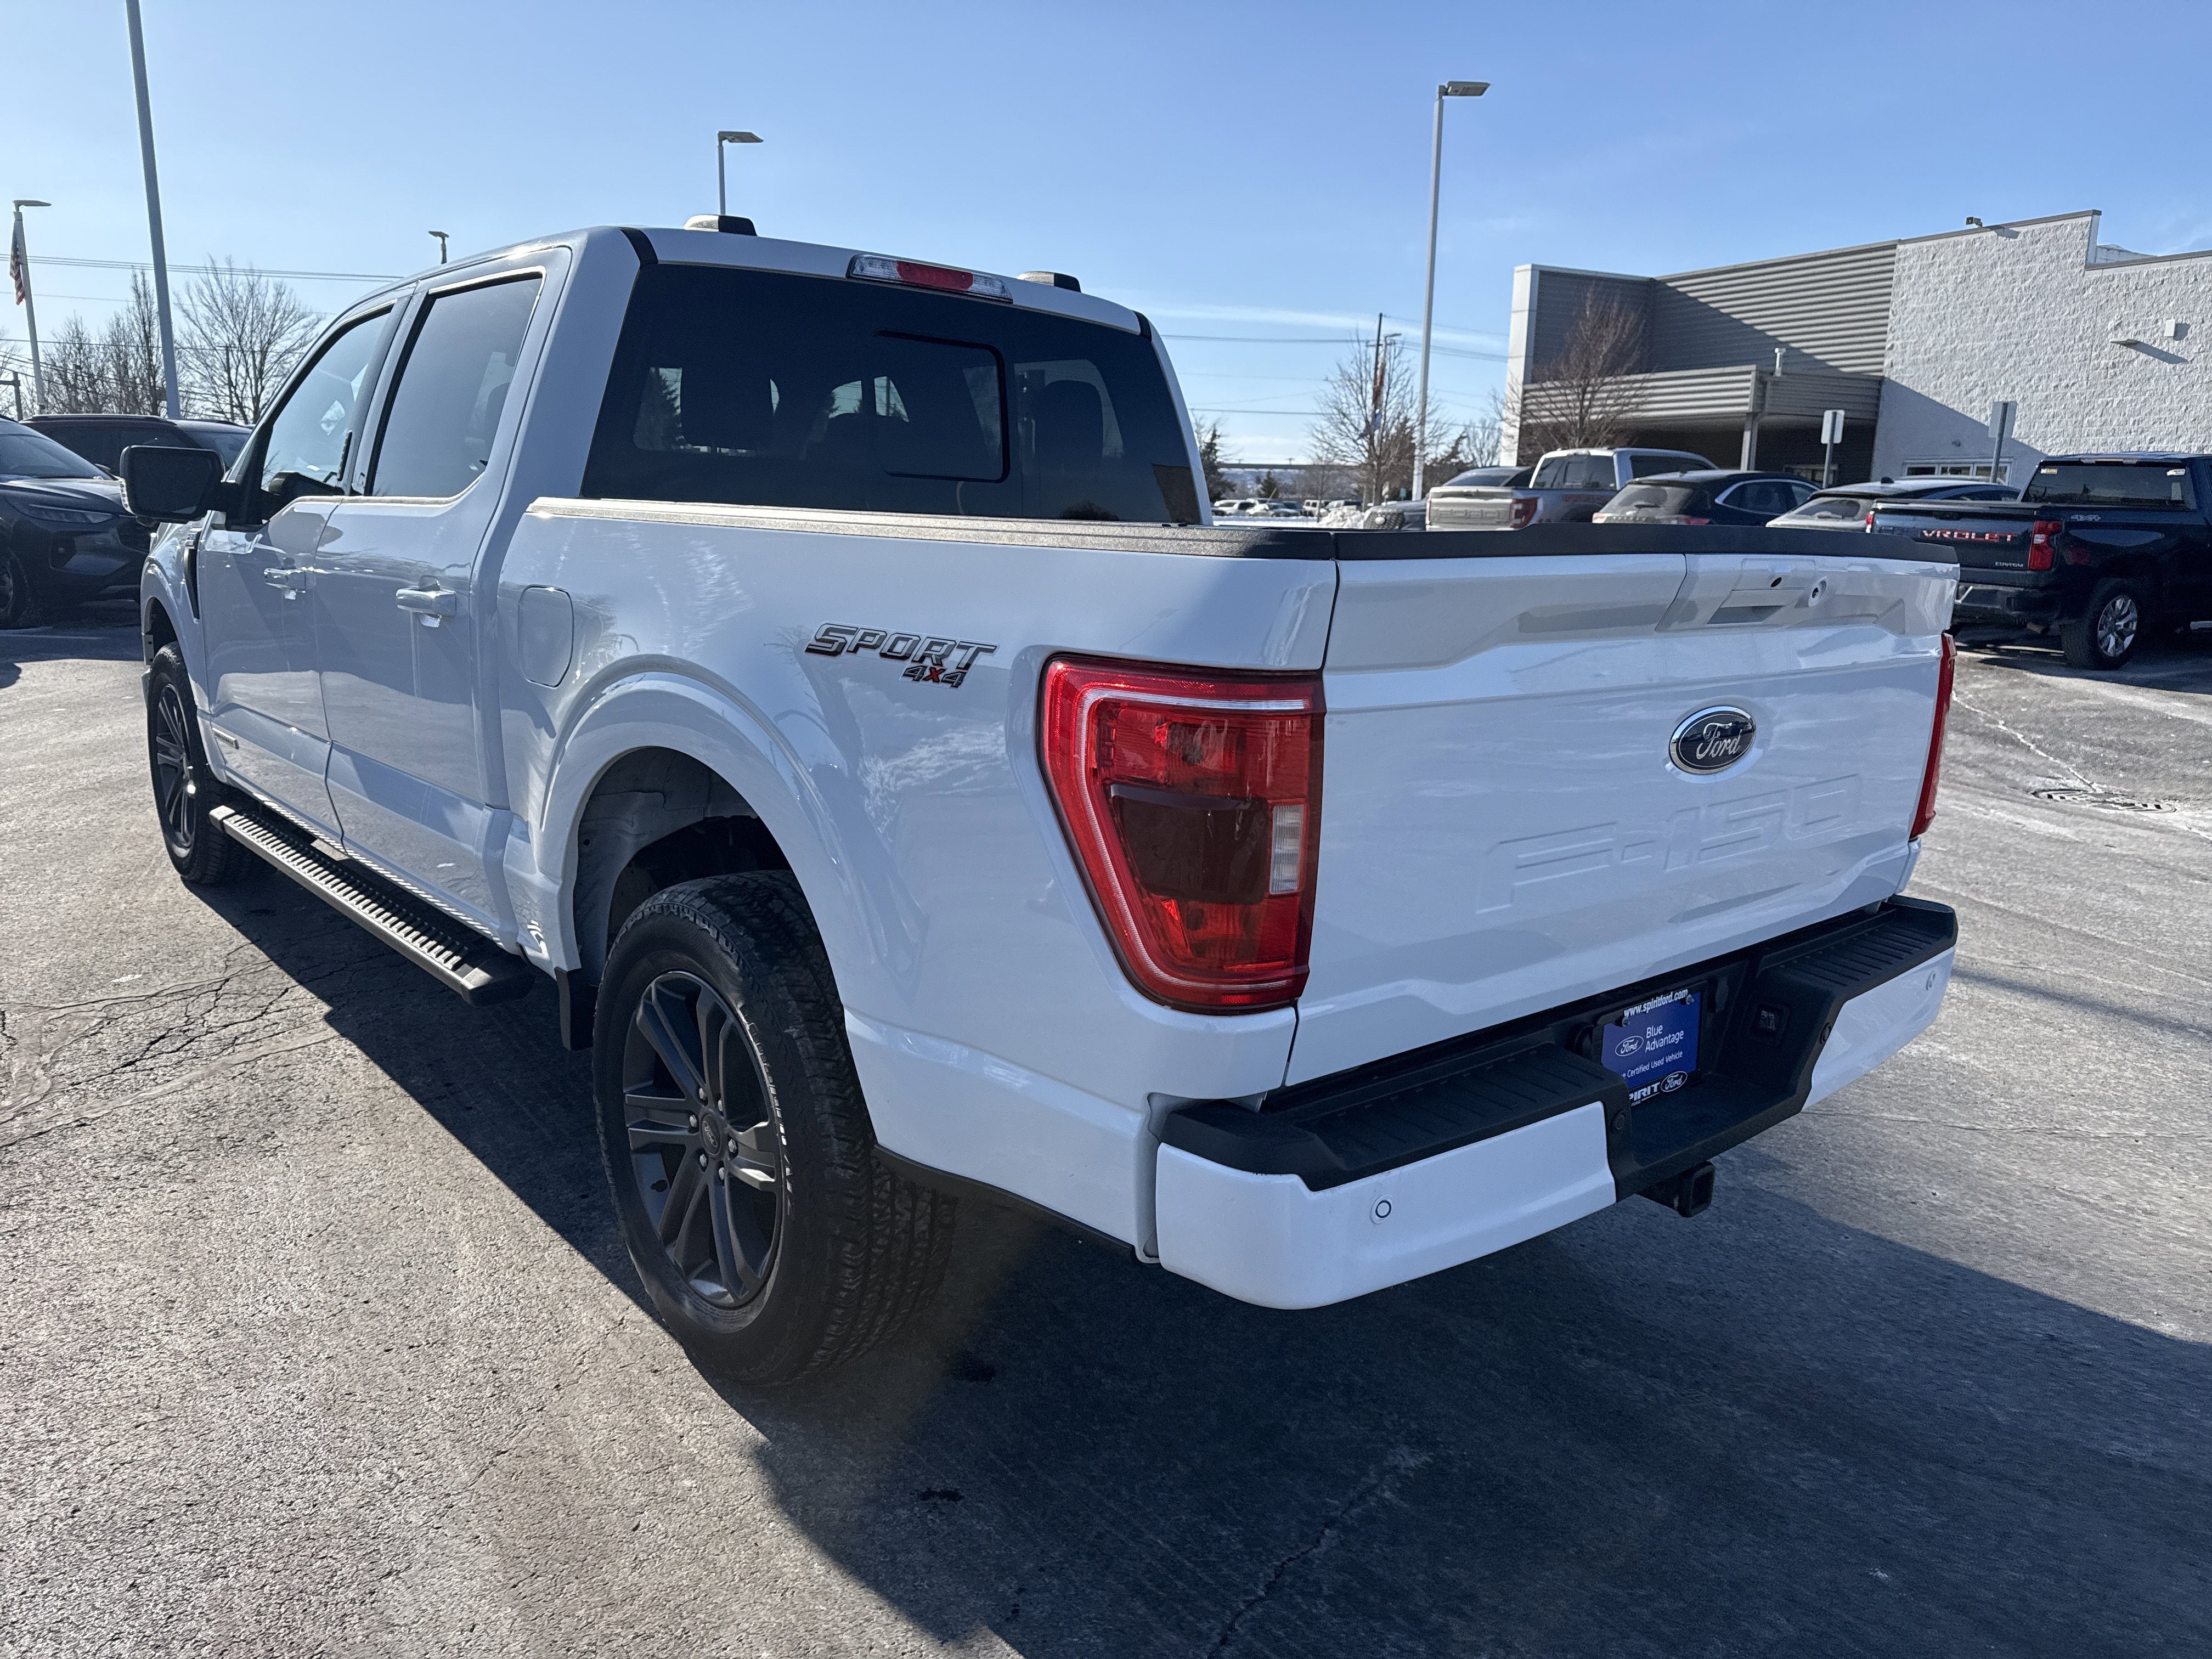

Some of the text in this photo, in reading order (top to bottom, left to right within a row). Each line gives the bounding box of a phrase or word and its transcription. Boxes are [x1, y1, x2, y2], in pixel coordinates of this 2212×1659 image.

[804, 621, 1000, 671] SPORT
[1696, 721, 1744, 760] Ford
[1476, 773, 1860, 915] F-150
[1623, 989, 1689, 1018] www.spiritford.com
[1645, 1030, 1685, 1053] Advantage
[1646, 1024, 1663, 1039] Blue
[1620, 1038, 1638, 1054] Ford
[1627, 1063, 1650, 1078] Certified
[1651, 1056, 1664, 1069] Used
[1665, 1050, 1683, 1063] Vehicle
[1629, 1082, 1661, 1101] PIRIT
[1664, 1074, 1683, 1091] Ford
